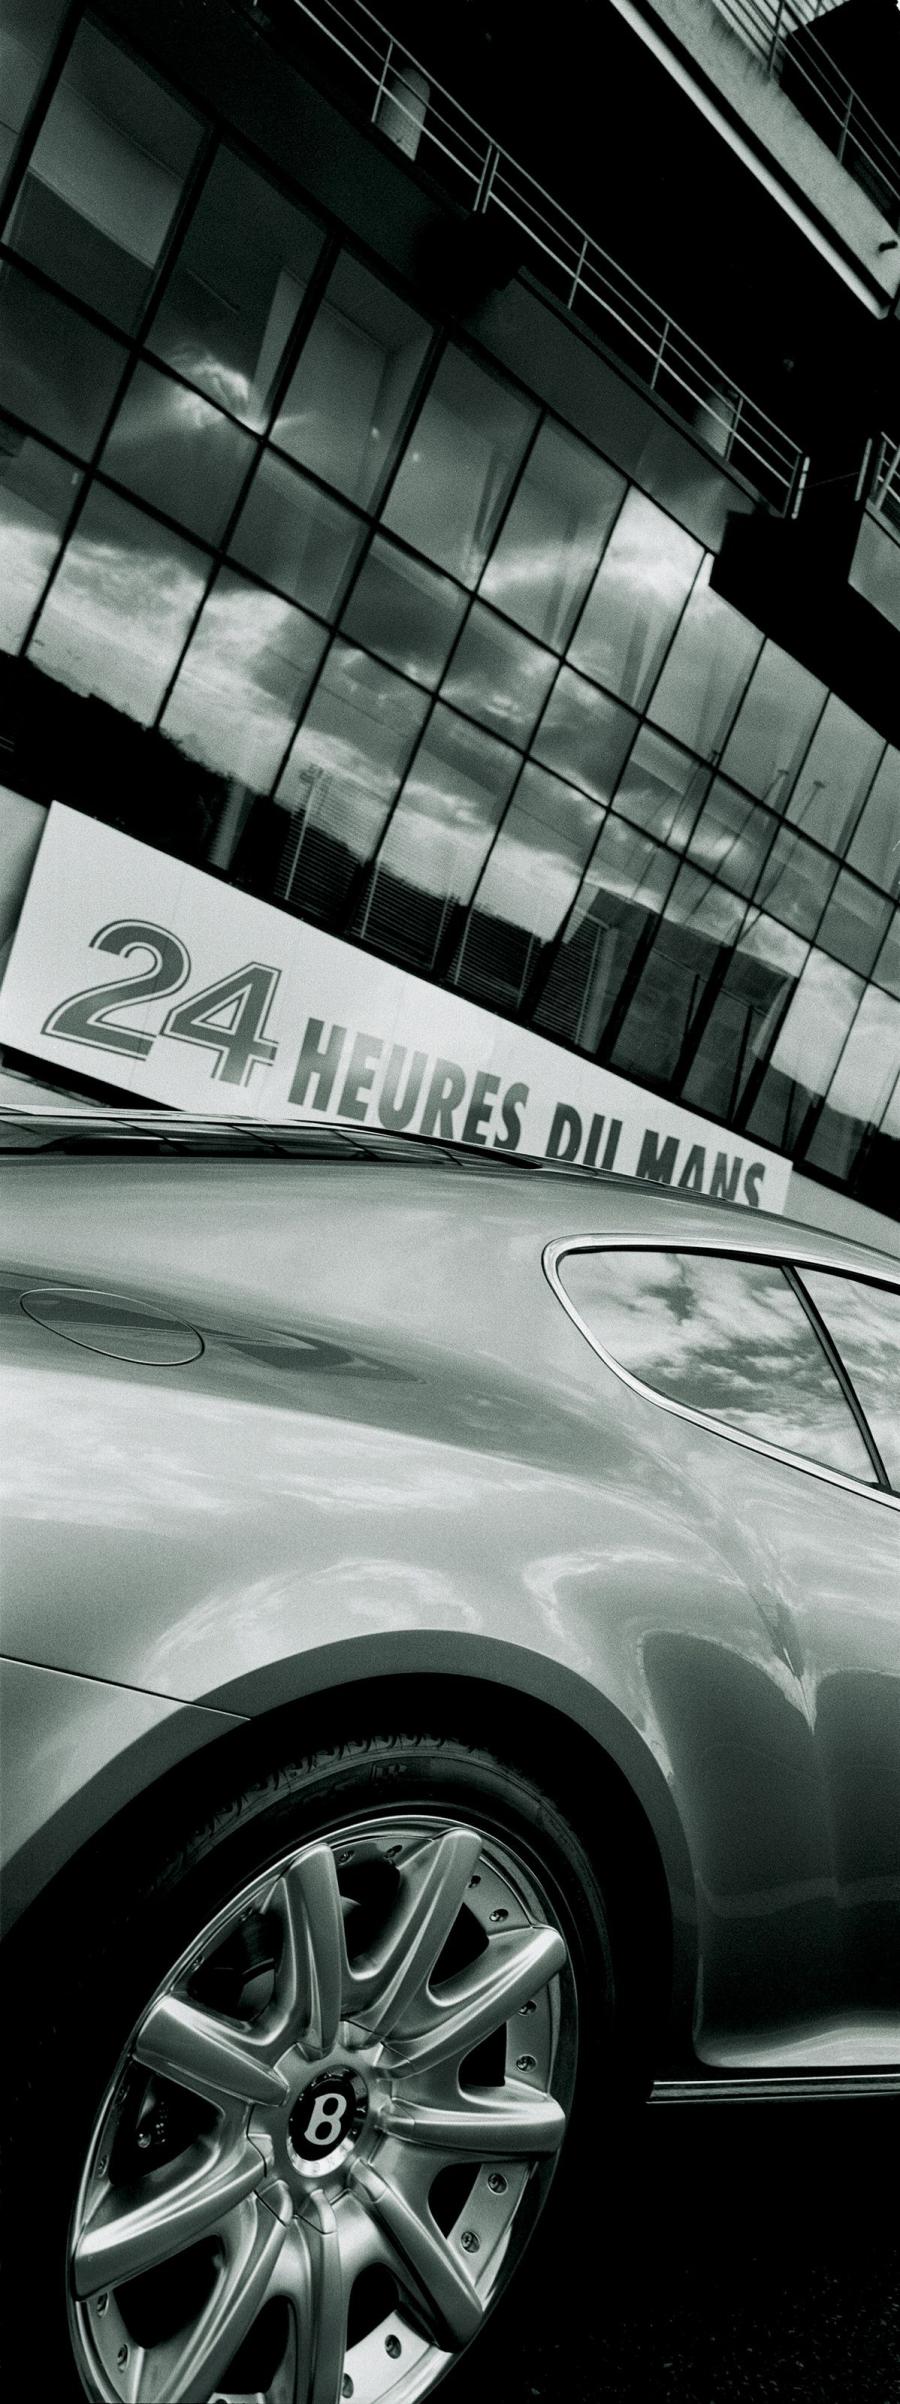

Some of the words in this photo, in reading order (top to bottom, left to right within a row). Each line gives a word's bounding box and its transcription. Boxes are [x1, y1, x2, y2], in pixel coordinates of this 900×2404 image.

[40, 918, 282, 1088] 24
[287, 1017, 531, 1151] HEURES
[544, 1102, 624, 1170] DU
[635, 1129, 765, 1208] MANS
[304, 2092, 347, 2145] B
